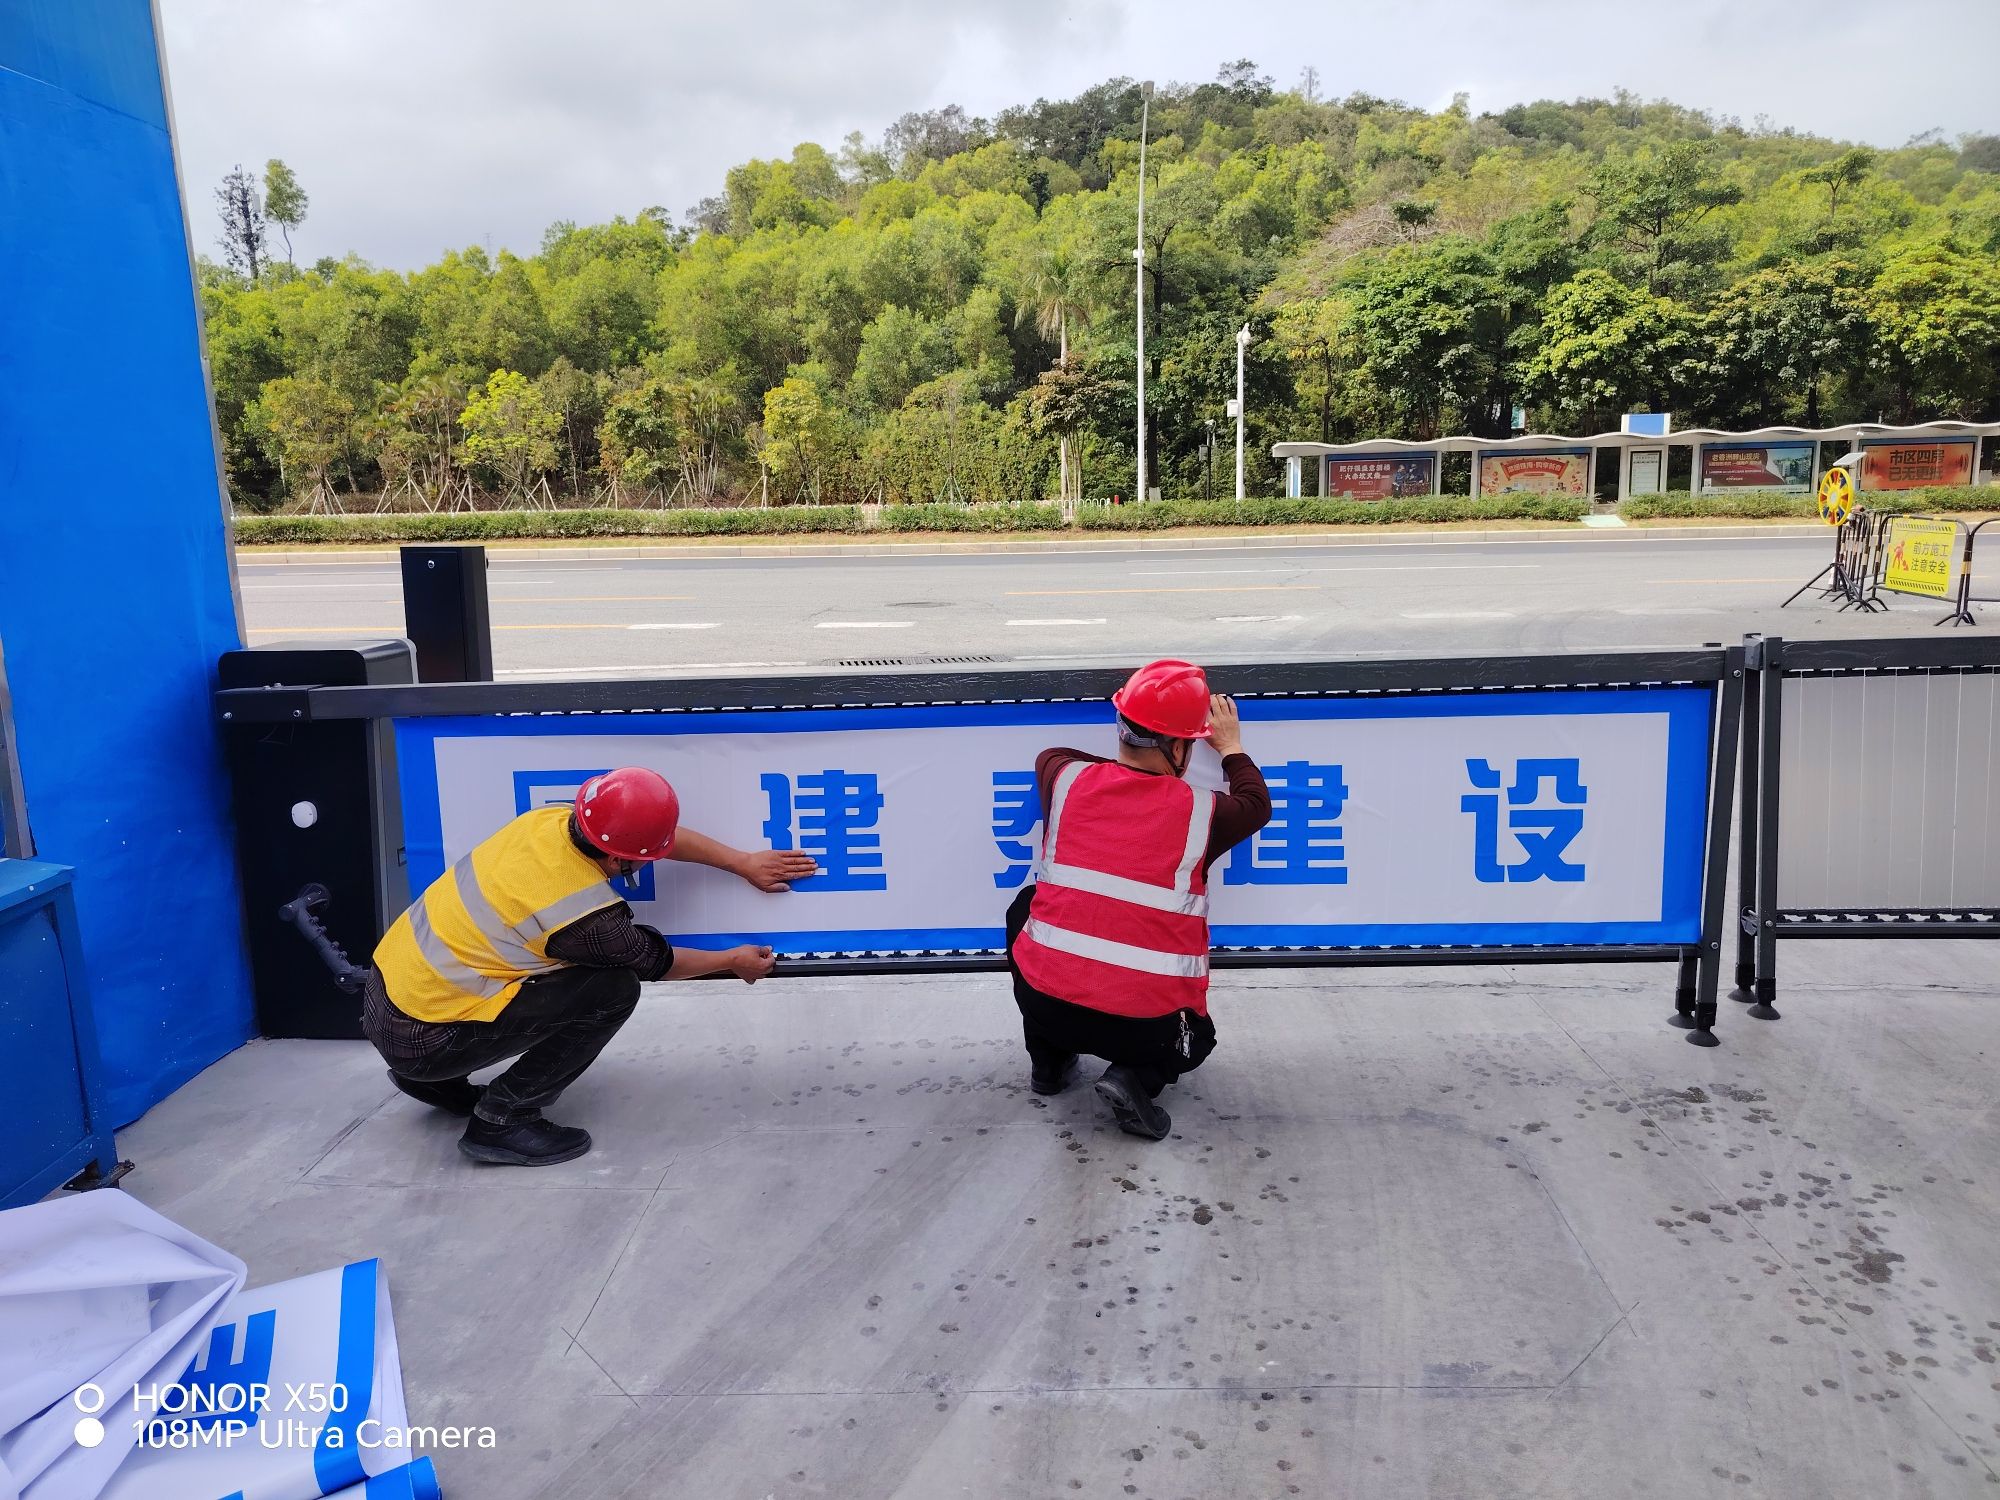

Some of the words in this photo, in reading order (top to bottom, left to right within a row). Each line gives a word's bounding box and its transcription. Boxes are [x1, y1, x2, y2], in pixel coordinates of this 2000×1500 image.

[1889, 449, 1945, 466] 市区四房
[1913, 541, 1949, 557] 前方施工
[1911, 558, 1947, 575] 注意安全
[513, 757, 1588, 902] 建建设
